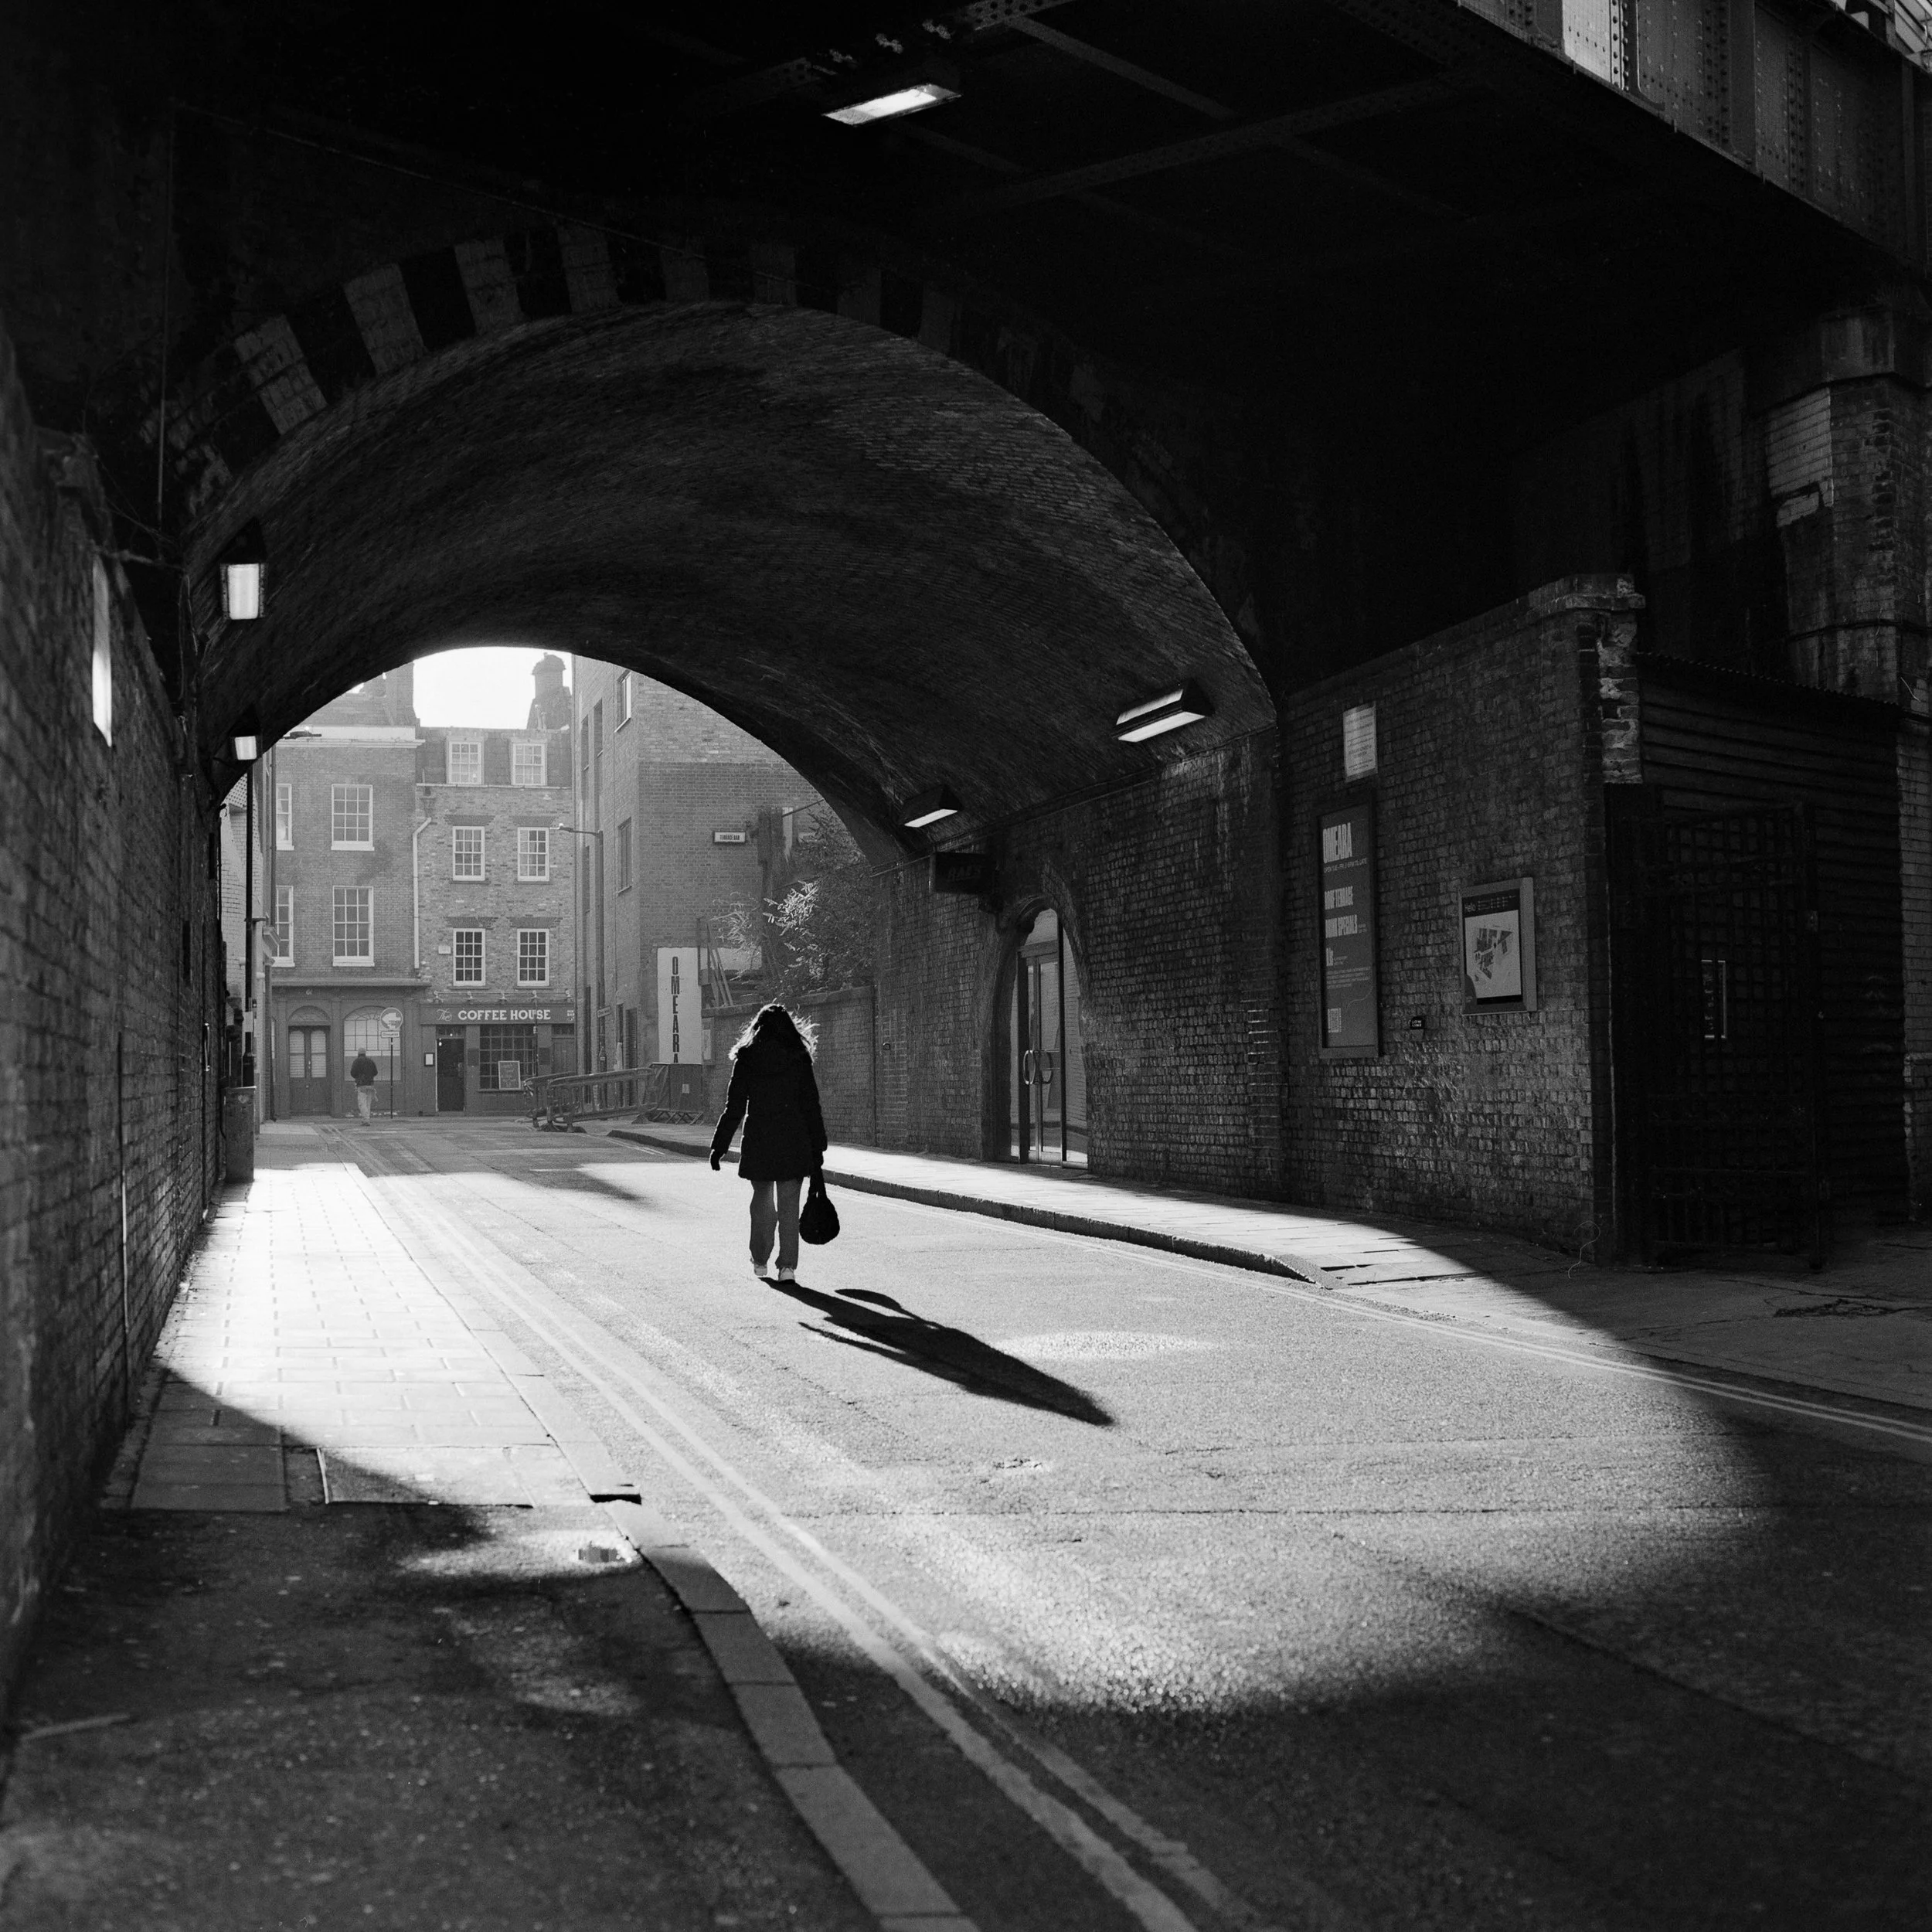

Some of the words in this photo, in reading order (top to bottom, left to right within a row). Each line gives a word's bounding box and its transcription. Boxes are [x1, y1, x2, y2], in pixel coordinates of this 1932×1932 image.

[1323, 822, 1353, 864] OMEARA
[457, 1009, 507, 1020] COFFEE
[510, 1009, 551, 1020] HOUSE
